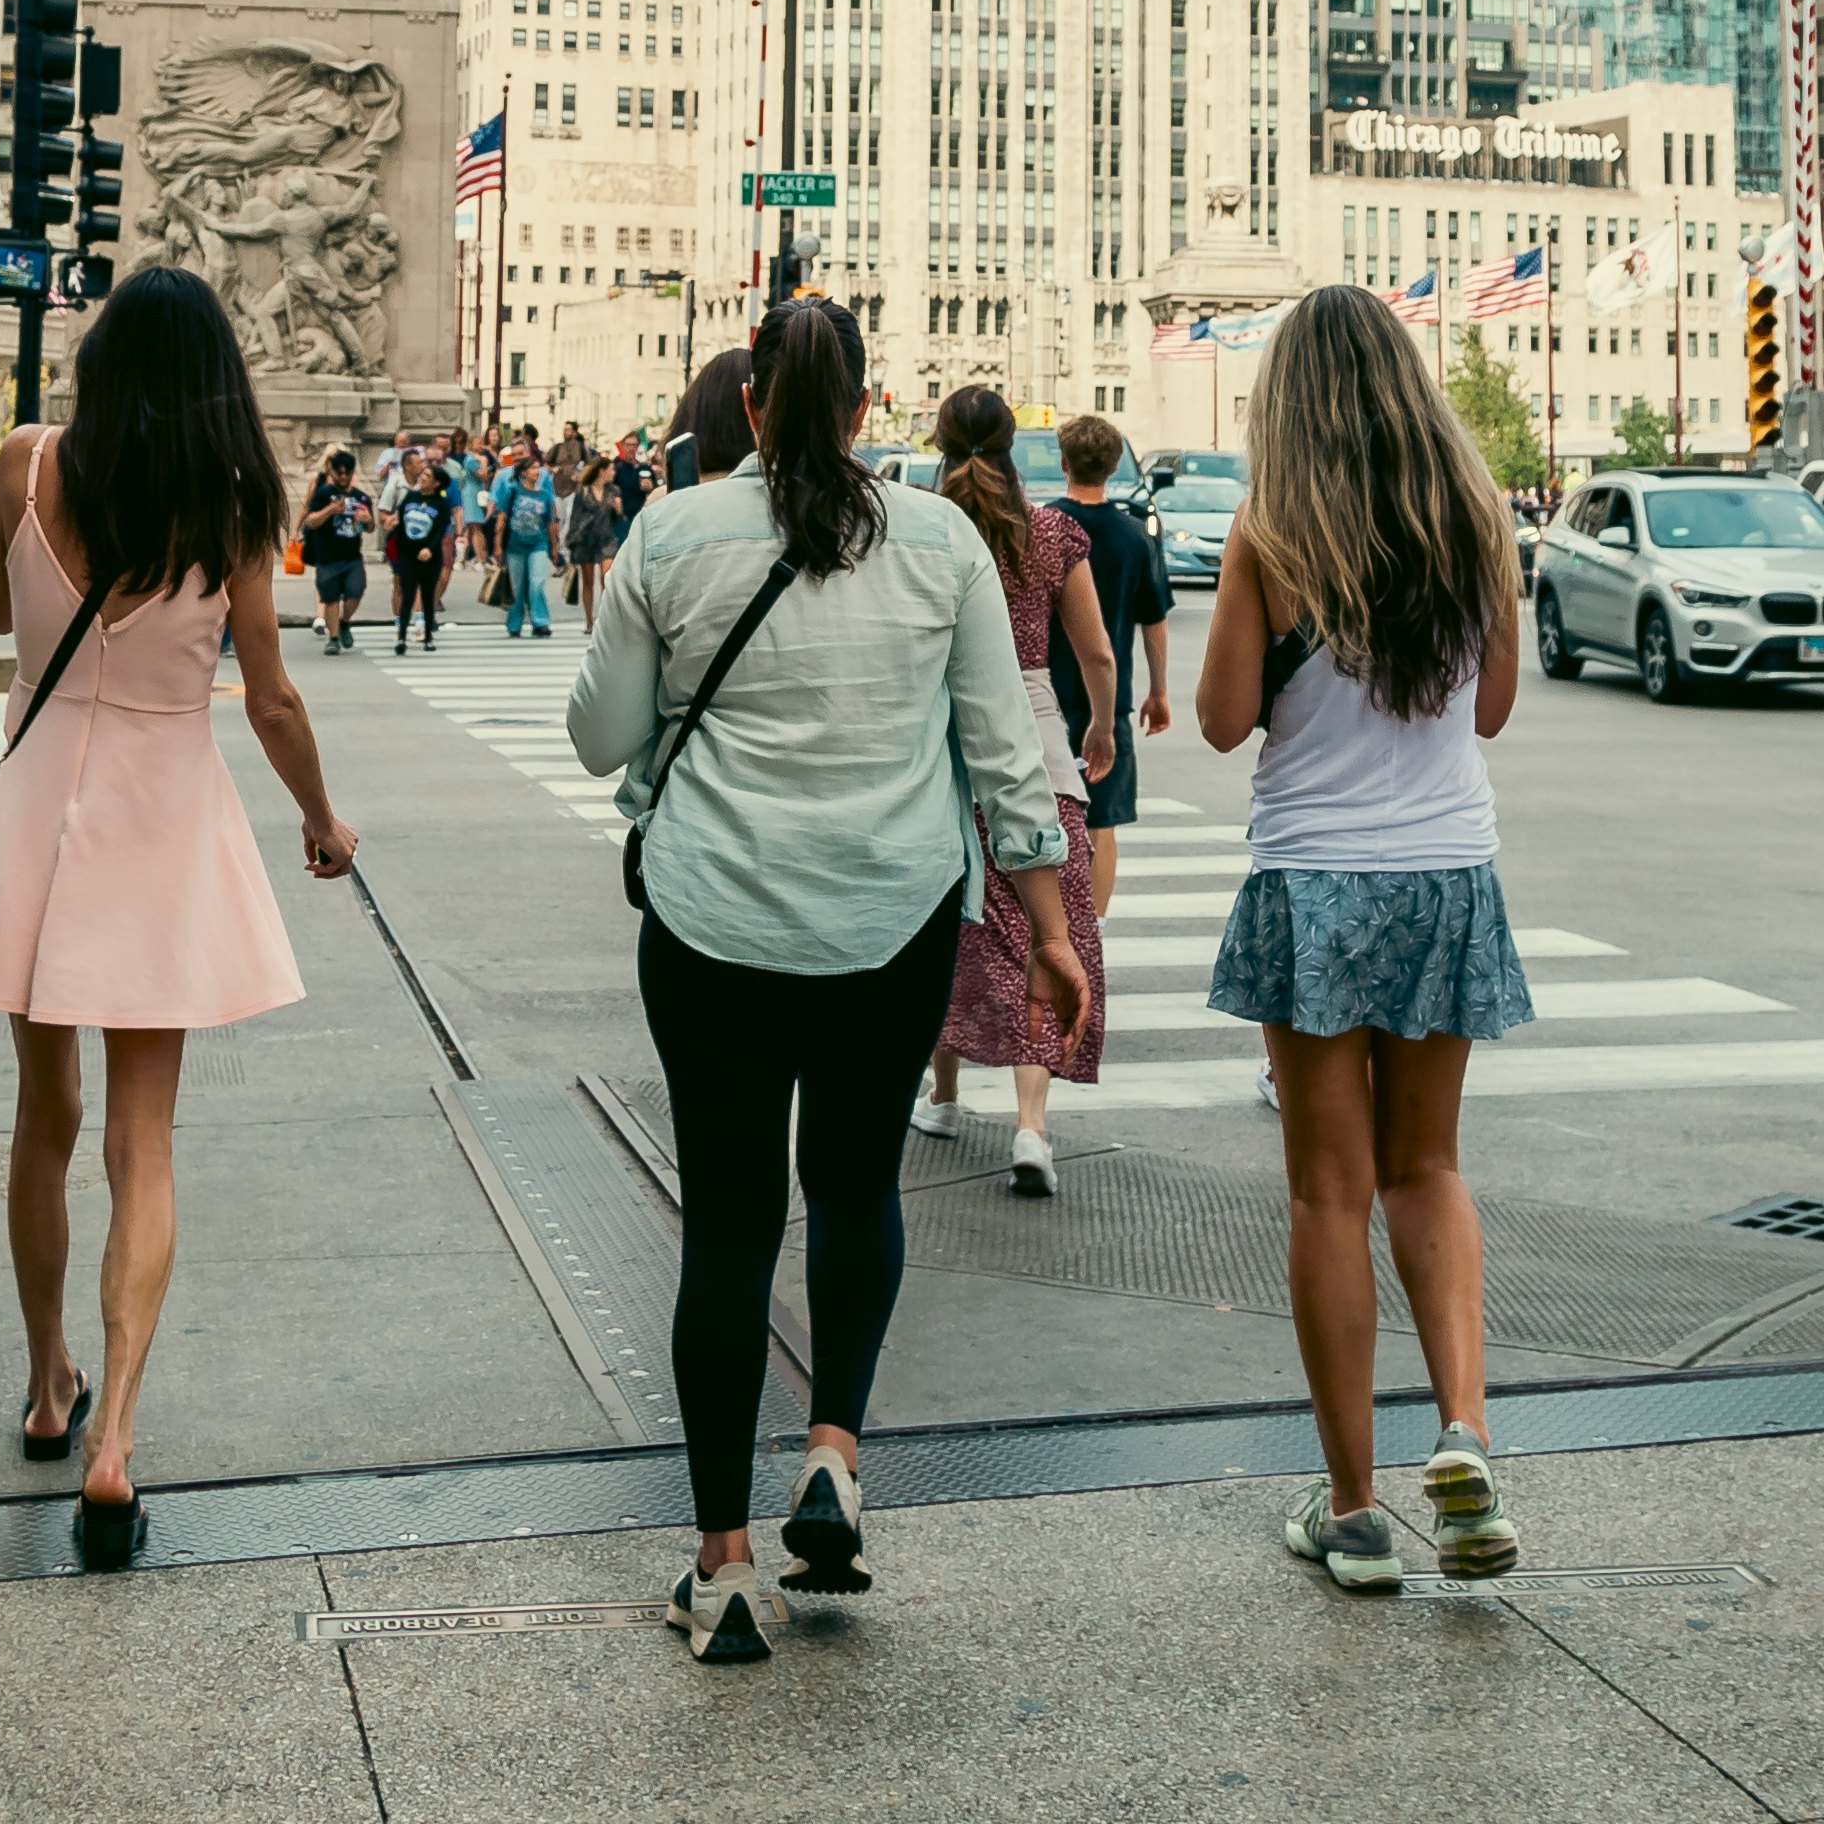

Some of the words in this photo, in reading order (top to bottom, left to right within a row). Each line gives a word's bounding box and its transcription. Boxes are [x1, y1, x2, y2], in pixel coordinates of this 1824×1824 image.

[1345, 109, 1482, 161] Chicago
[1492, 114, 1623, 163] Tribune
[1436, 1579, 1472, 1593] OF
[1491, 1578, 1563, 1591] FORT
[525, 1611, 604, 1625] FORT
[625, 1609, 663, 1622] OF
[342, 1615, 503, 1633] DEARBORN
